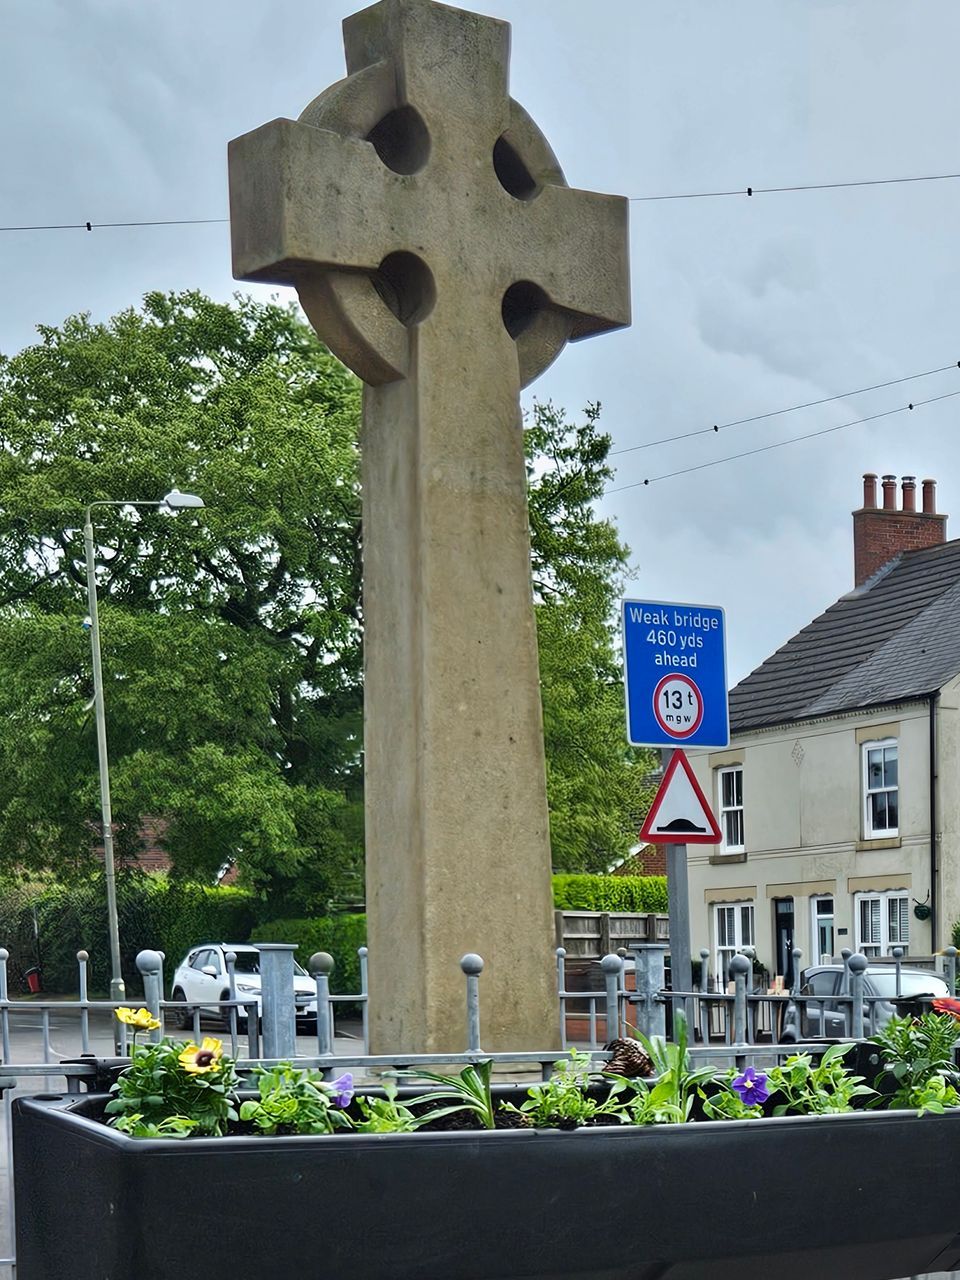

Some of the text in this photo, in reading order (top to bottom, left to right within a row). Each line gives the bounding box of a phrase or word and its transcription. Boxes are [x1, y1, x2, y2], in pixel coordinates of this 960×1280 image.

[629, 607, 719, 632] Weak bridge
[646, 629, 703, 650] 460 yds
[654, 652, 697, 668] ahead
[663, 690, 693, 710] 13 t
